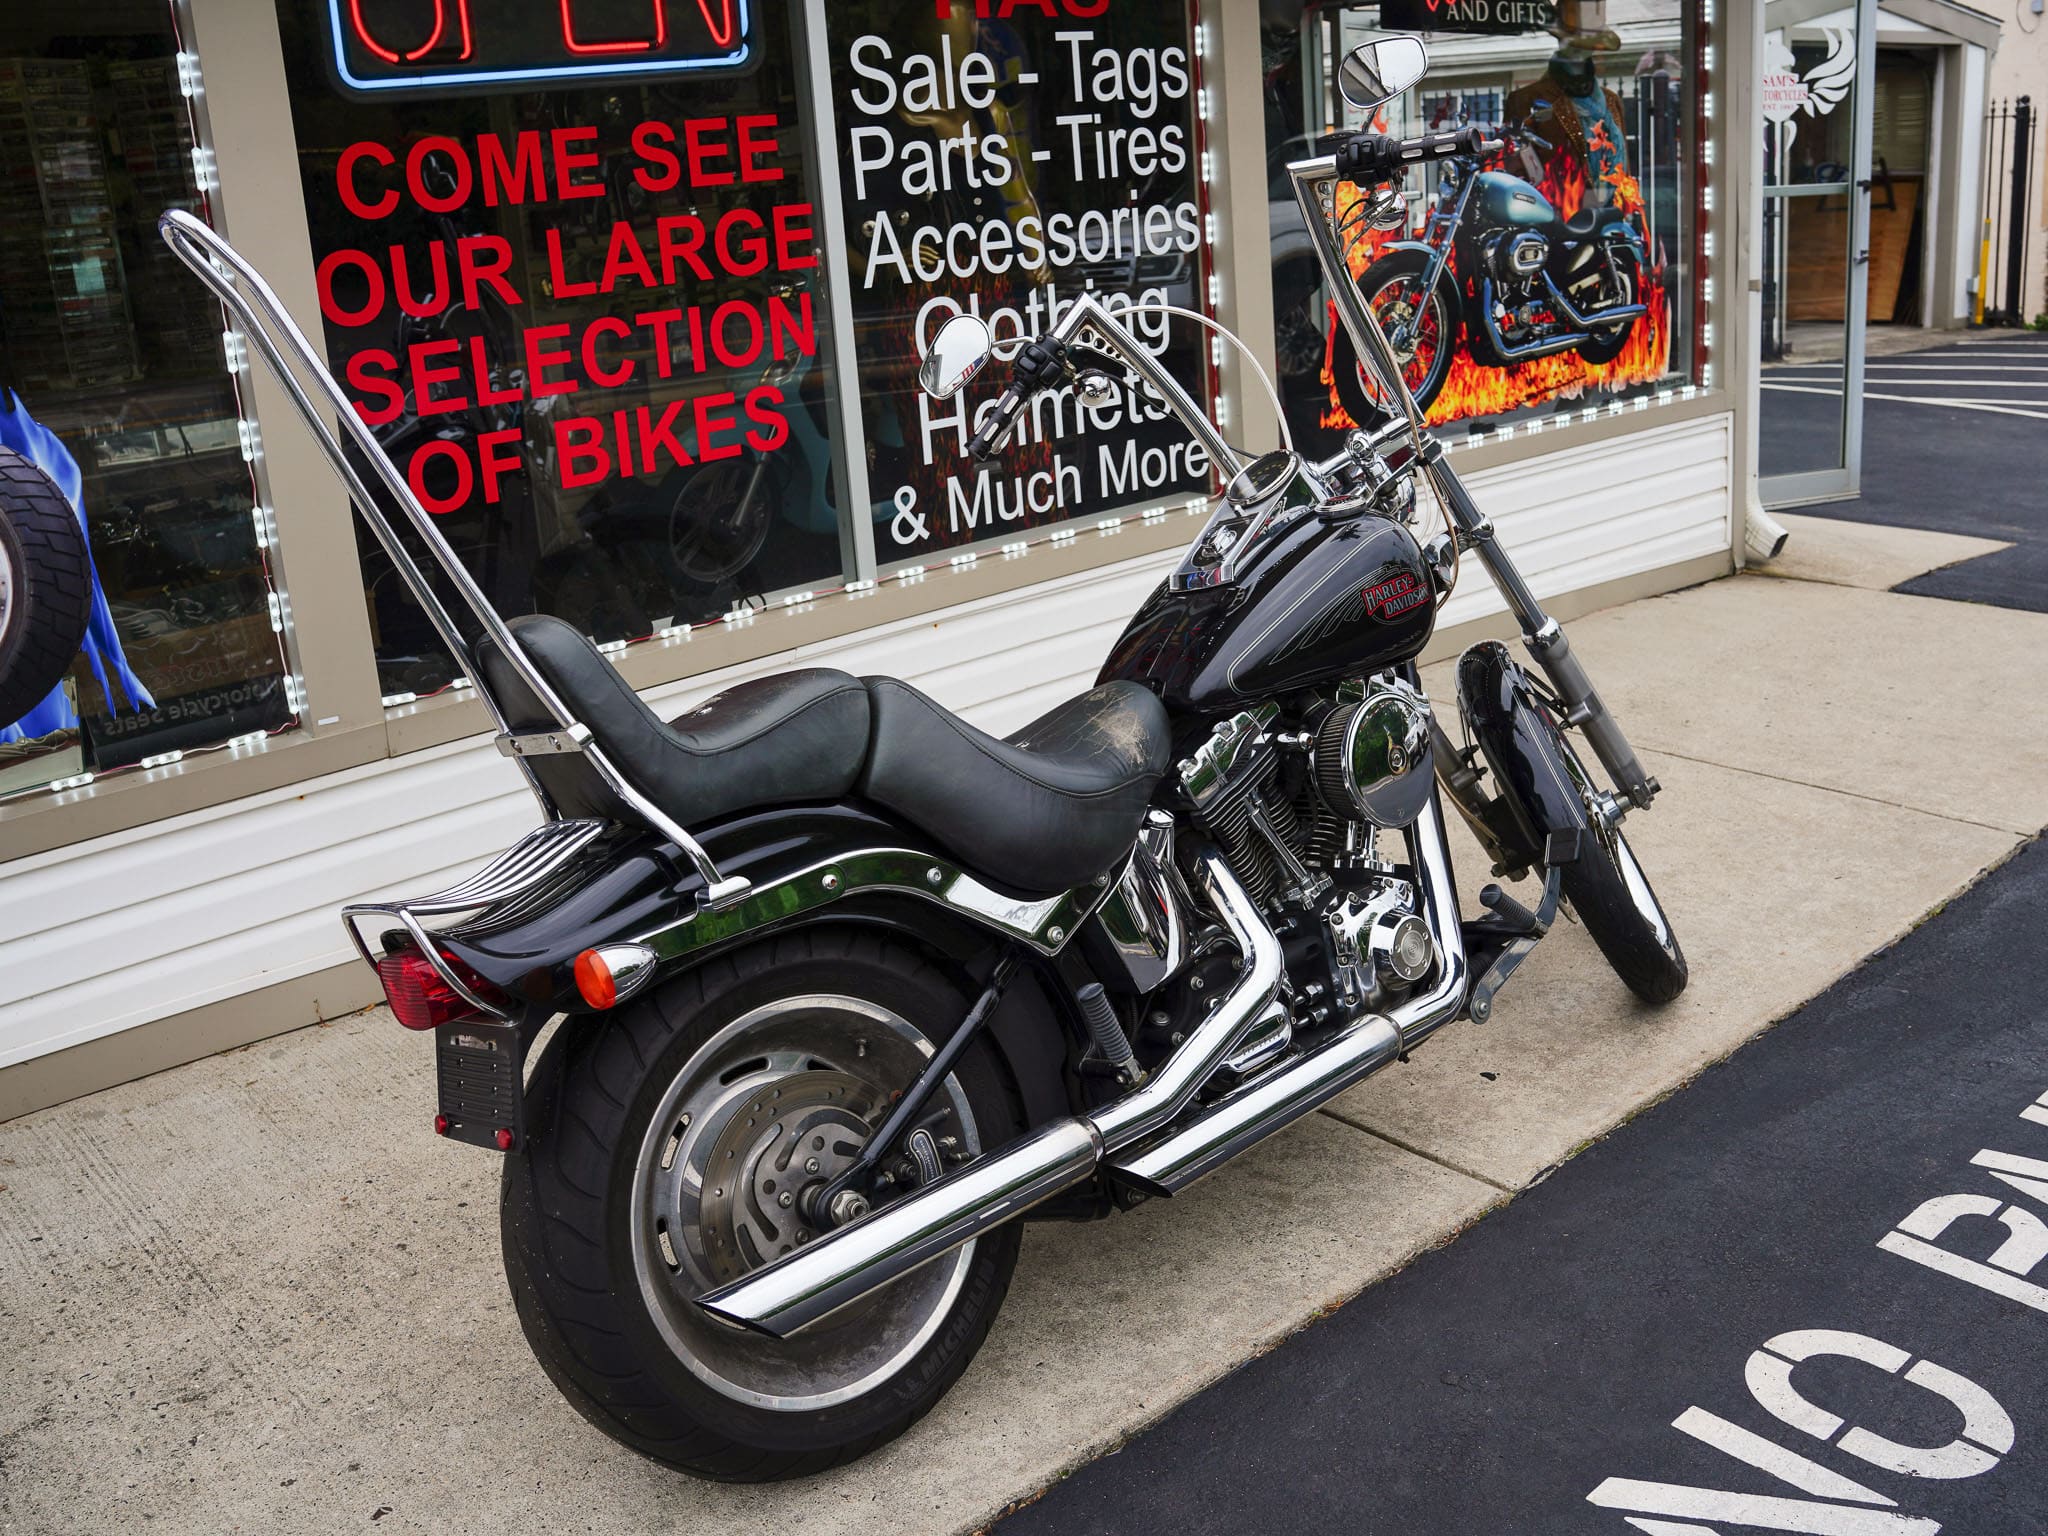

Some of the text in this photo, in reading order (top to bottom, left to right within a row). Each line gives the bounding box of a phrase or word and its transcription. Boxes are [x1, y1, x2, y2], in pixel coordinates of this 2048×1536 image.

[1447, 0, 1546, 25] AND GIFTS
[850, 34, 996, 115] Sale
[1055, 31, 1188, 119] Tags
[336, 114, 784, 220] COME SEE
[850, 120, 1012, 201] Parts
[1056, 113, 1186, 182] Tires
[317, 203, 819, 327] OUR LARGE
[863, 190, 1201, 289] Accessories
[346, 293, 816, 425] SELECTION
[408, 385, 789, 514] OF BIKES
[891, 485, 930, 545] &
[946, 454, 1082, 533] Much
[1098, 440, 1209, 498] More
[1385, 585, 1429, 615] DAVIDSON
[920, 1258, 997, 1379] MICHELIN
